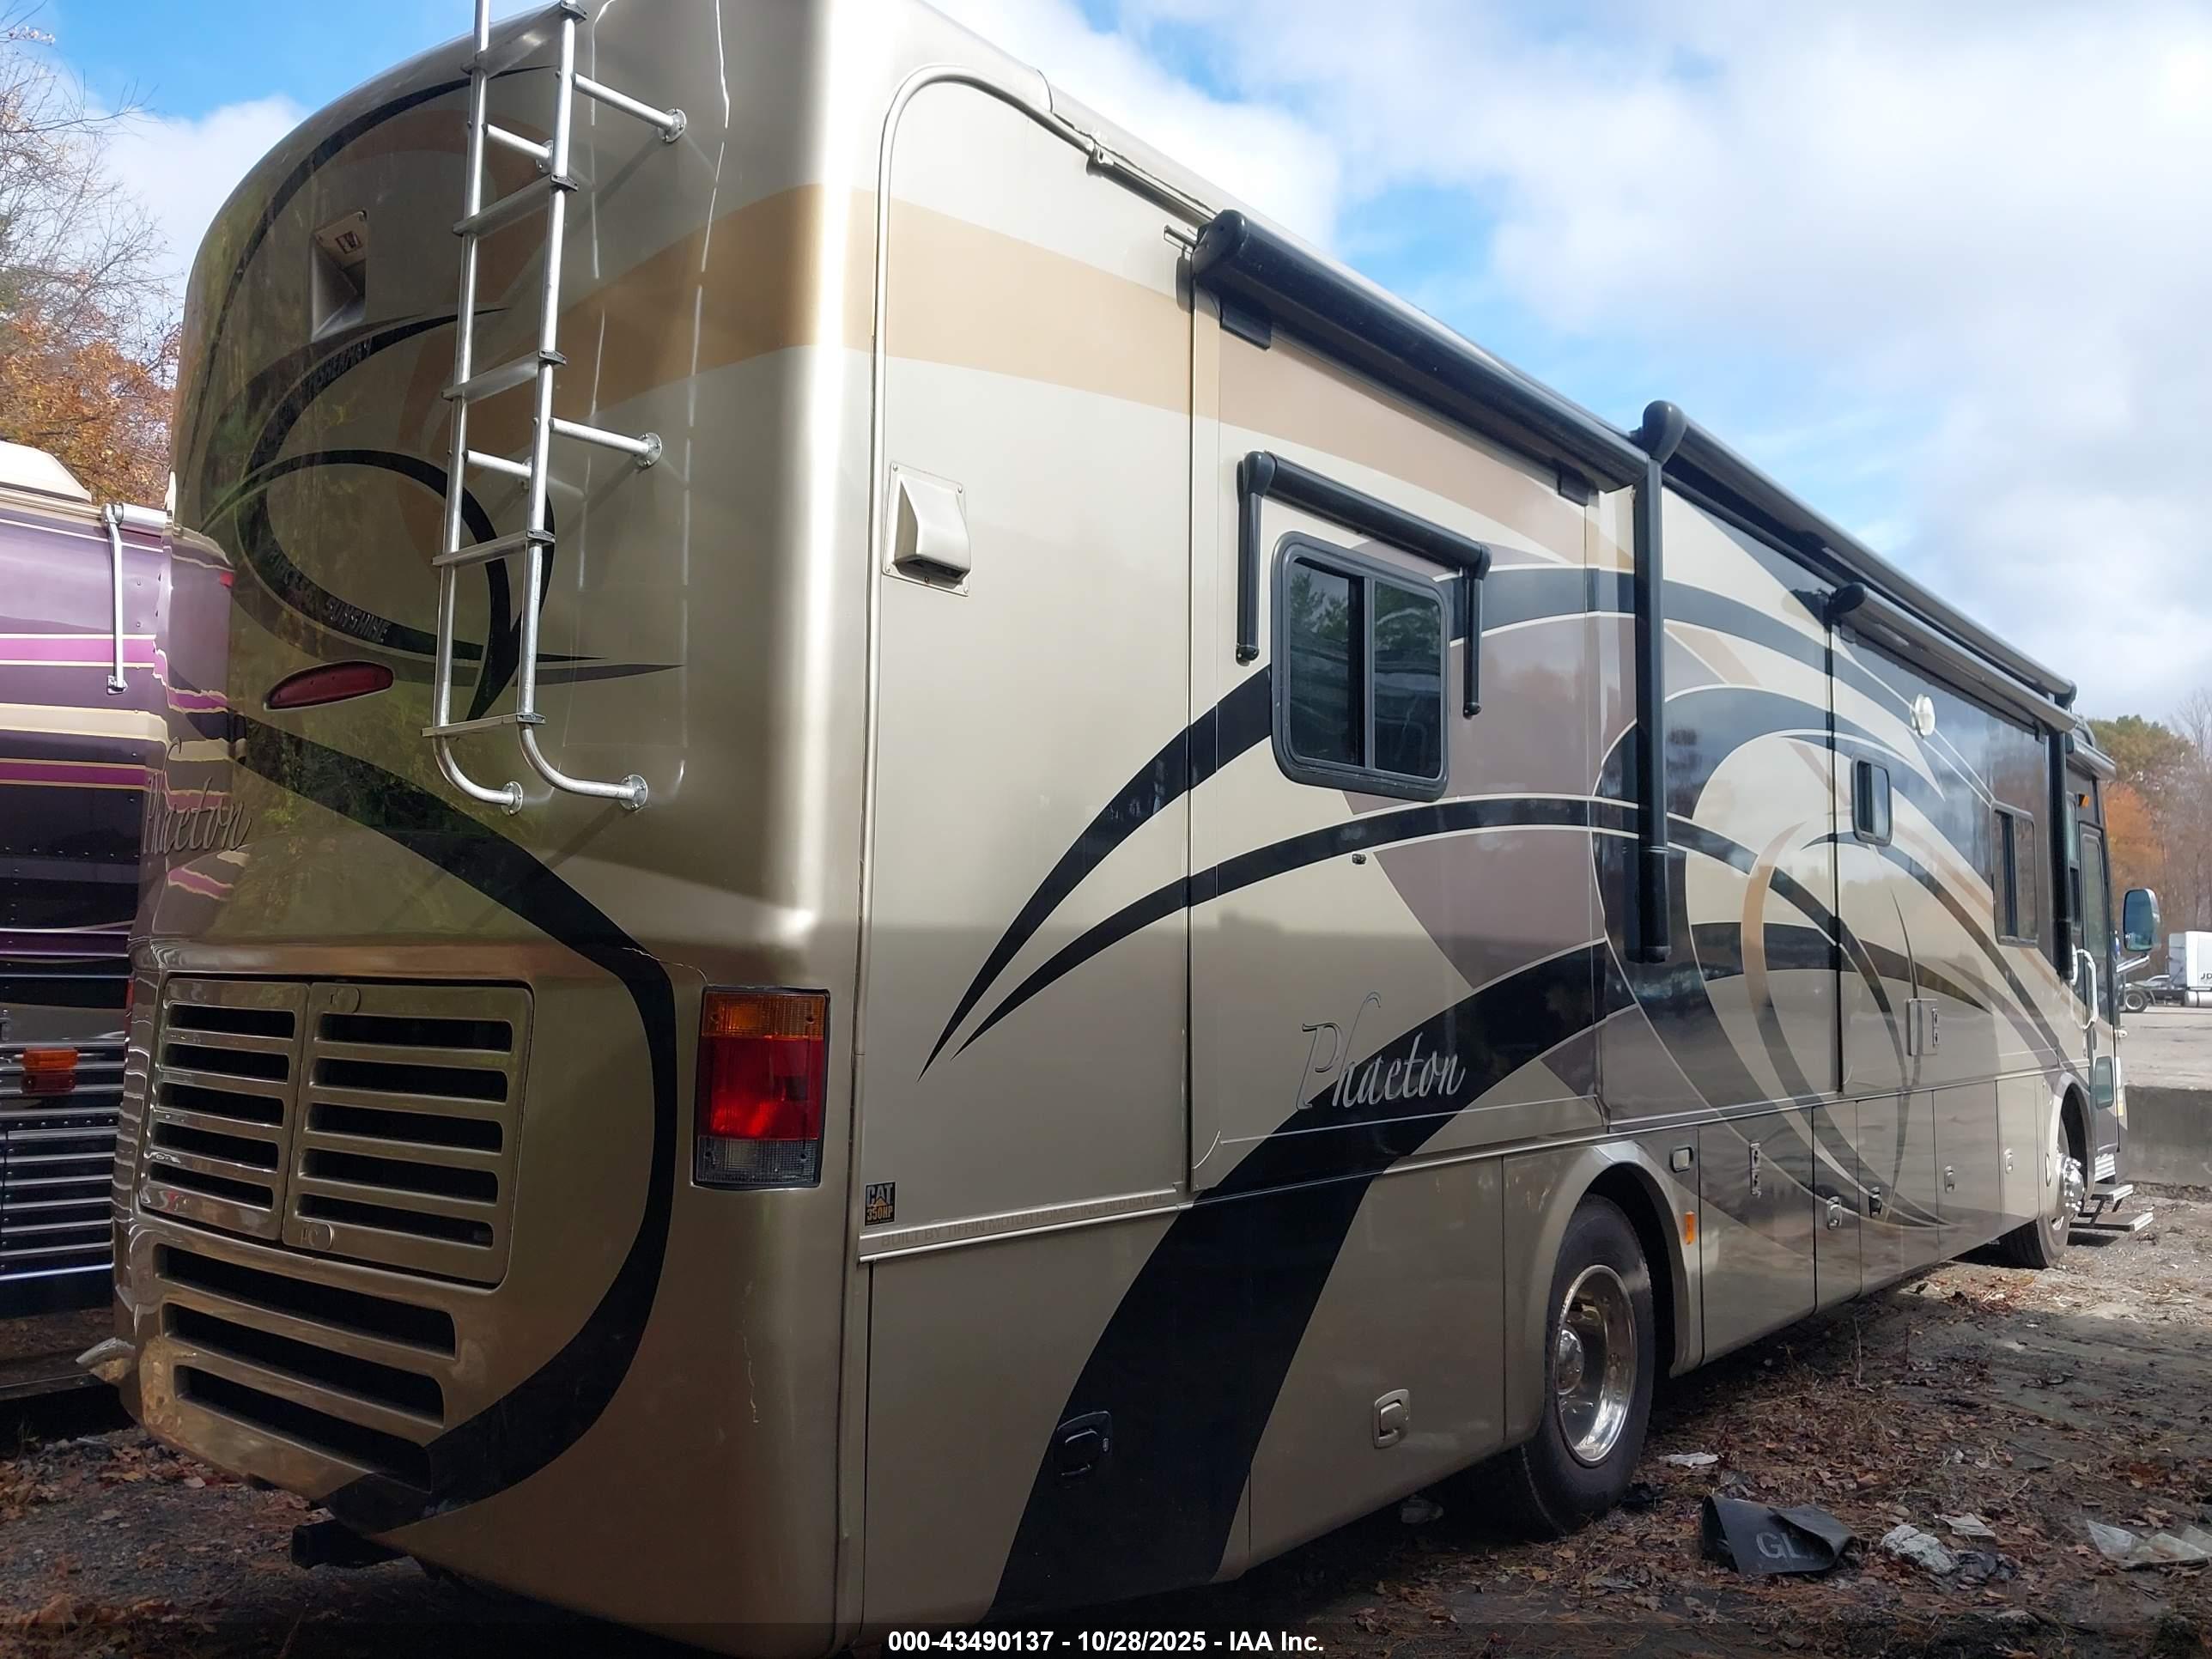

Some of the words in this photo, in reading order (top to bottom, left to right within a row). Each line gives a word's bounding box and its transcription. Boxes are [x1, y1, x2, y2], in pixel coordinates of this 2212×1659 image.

[143, 736, 252, 854] Phaeton
[1296, 990, 1466, 1110] Phaeton
[866, 1183, 893, 1207] CAT
[866, 1206, 893, 1221] 350HP
[924, 1227, 942, 1240] BY
[1756, 1531, 1813, 1559] GL
